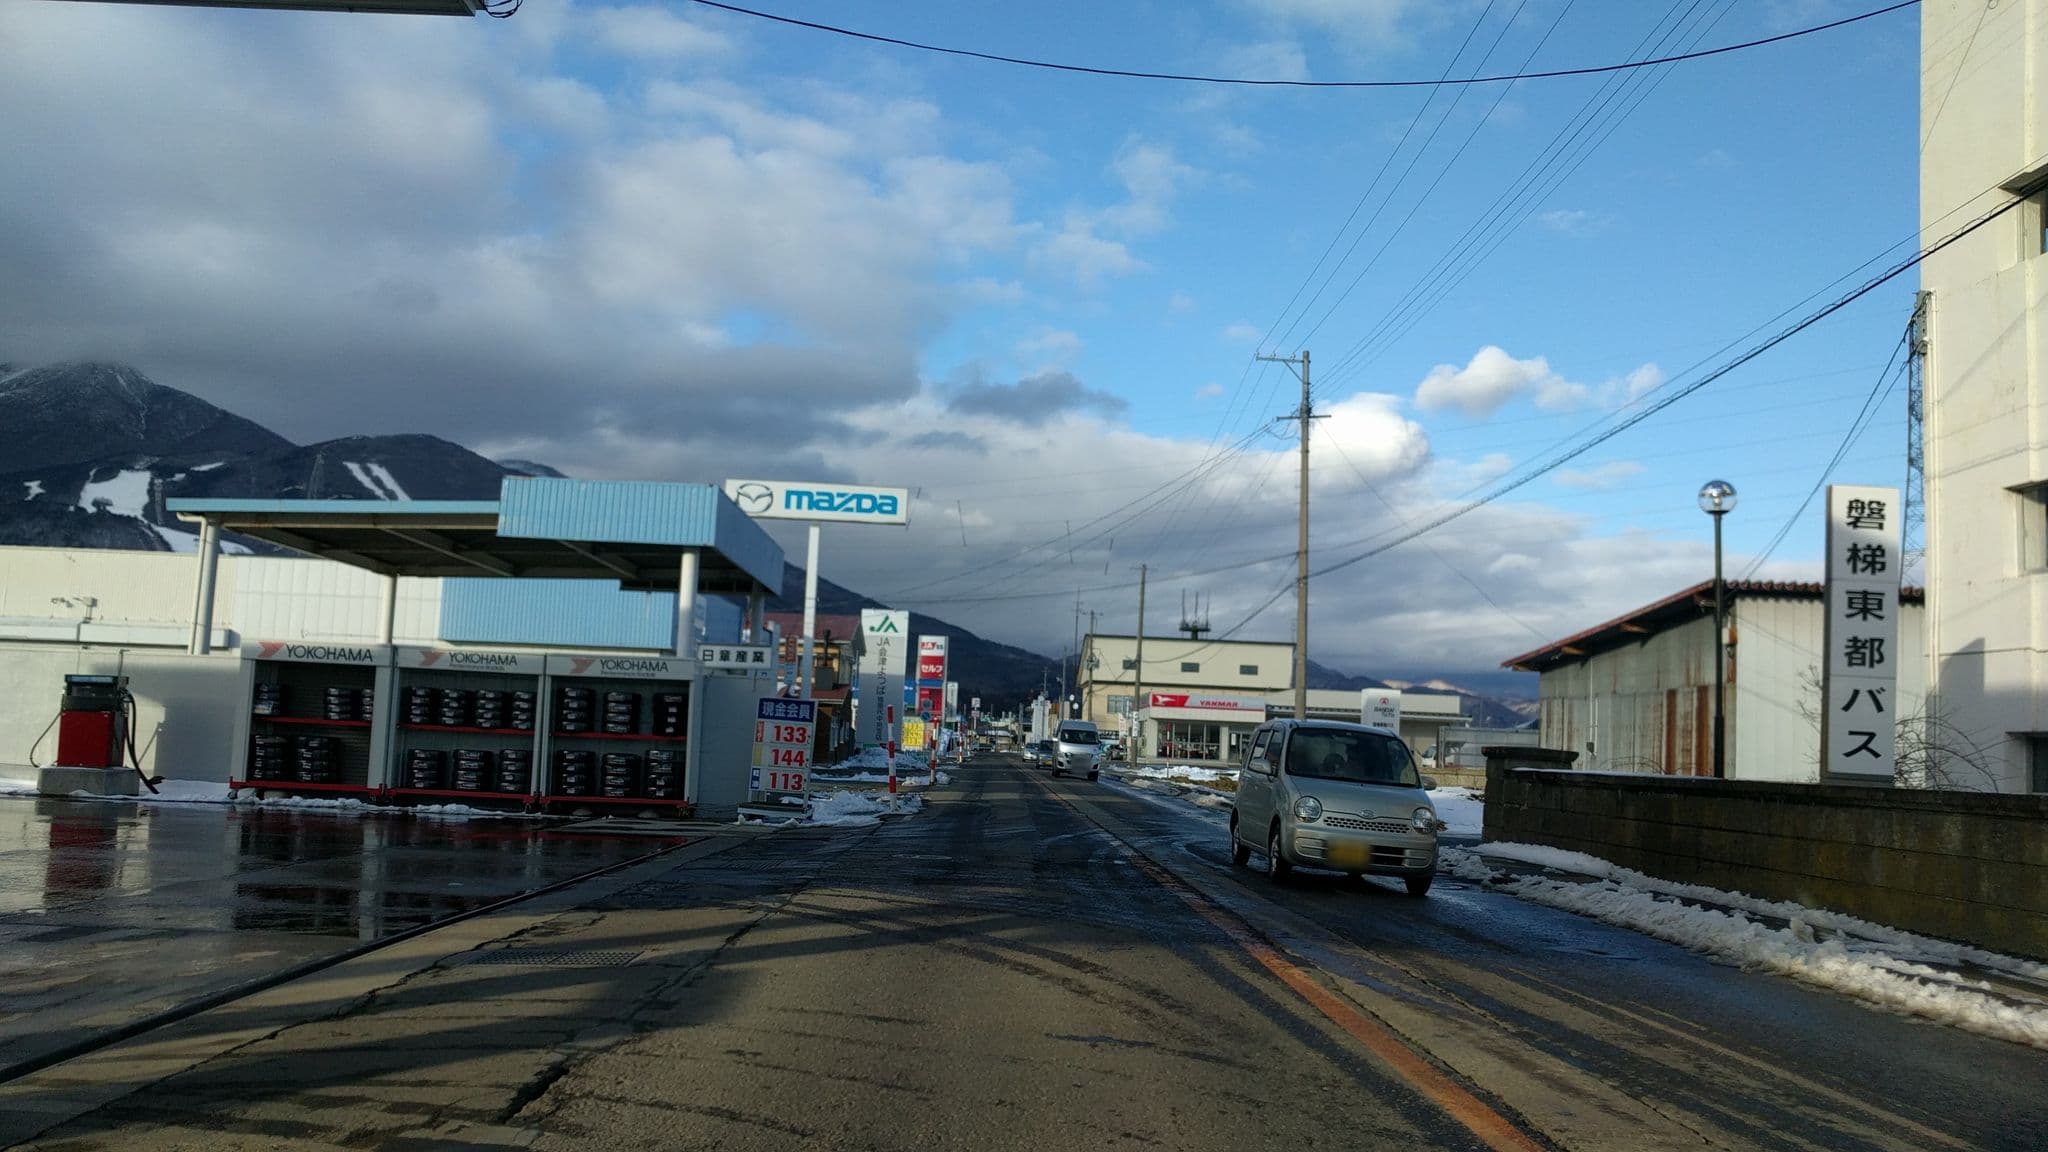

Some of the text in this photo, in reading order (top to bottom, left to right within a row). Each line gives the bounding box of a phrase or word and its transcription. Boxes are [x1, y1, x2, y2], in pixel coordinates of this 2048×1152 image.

[1841, 499, 1886, 759] 磐梯東都バス
[286, 644, 373, 663] YOKOHAMA
[449, 652, 517, 666] YOKOHAMA
[600, 658, 669, 672] YOKOHAMA
[921, 664, 943, 673] セルフ
[762, 702, 811, 719] 現金会員
[1200, 700, 1238, 708] YANMAR
[774, 725, 807, 743] 133
[772, 749, 805, 767] 144
[769, 772, 803, 791] 113
